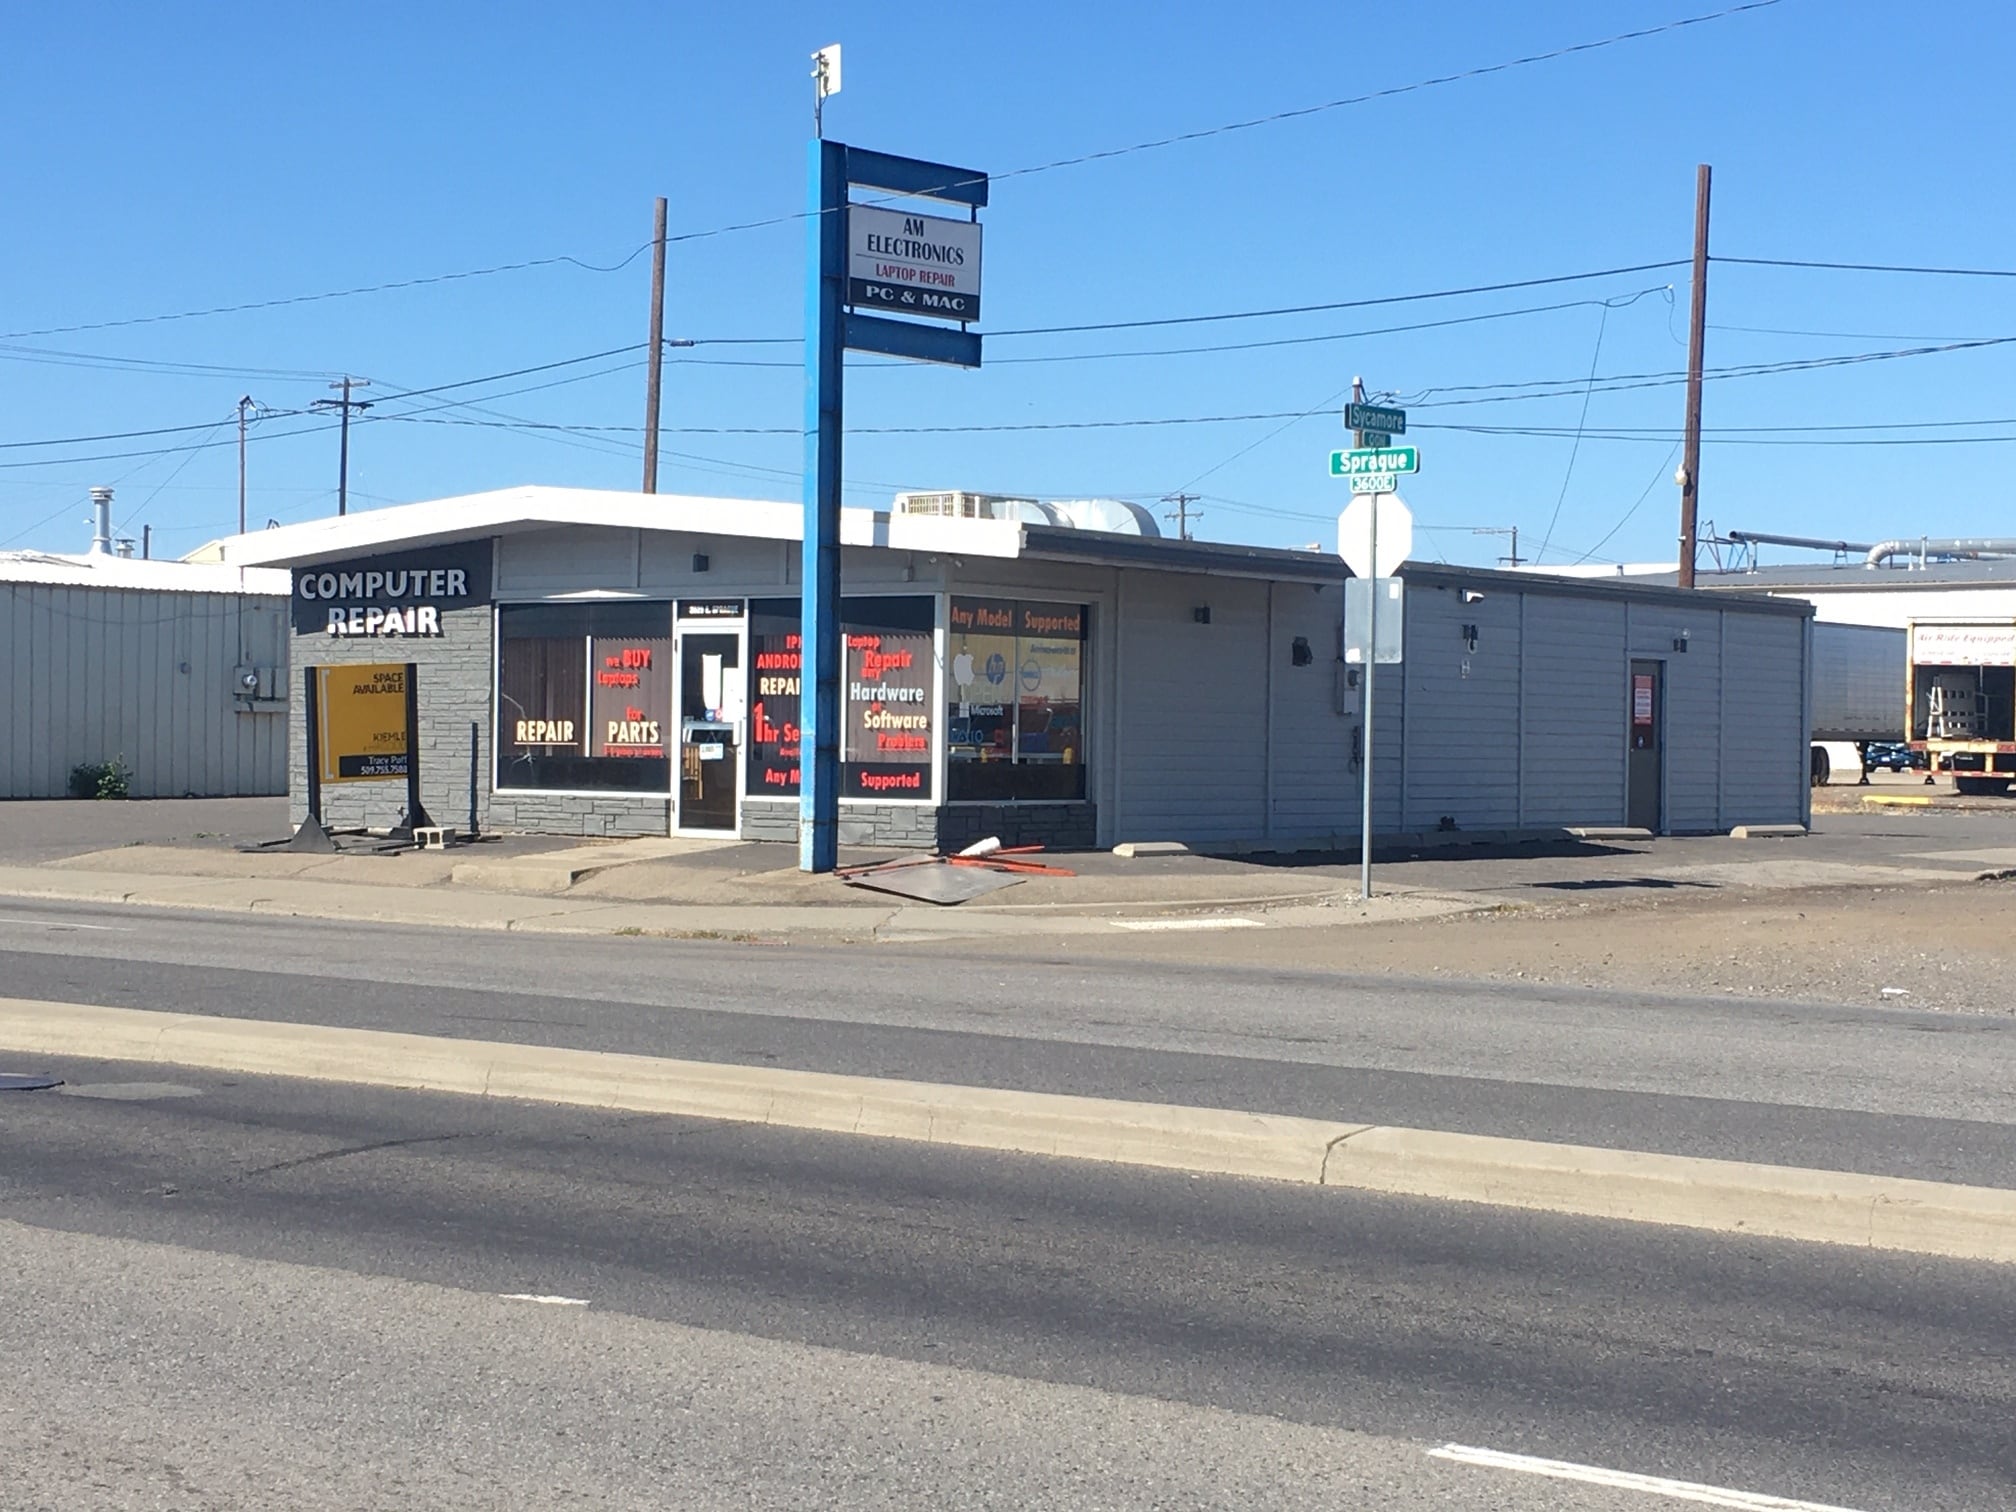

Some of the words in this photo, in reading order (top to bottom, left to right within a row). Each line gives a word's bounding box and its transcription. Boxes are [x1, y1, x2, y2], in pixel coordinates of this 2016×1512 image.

[903, 217, 924, 237] AM
[867, 233, 964, 266] ELECTRONICS
[875, 263, 916, 283] LAPTOP
[919, 269, 955, 288] REPAIR
[866, 285, 894, 300] PC
[900, 291, 916, 304] &
[922, 293, 965, 311] MAC
[1352, 406, 1403, 430] Sycamore
[1339, 452, 1408, 474] Sprague
[1354, 476, 1392, 490] 3600E
[299, 568, 468, 600] COMPUTER
[327, 605, 440, 635] REPAIR
[951, 606, 973, 628] Any
[976, 608, 1013, 628] Model
[1024, 609, 1081, 633] Supported
[847, 634, 881, 650] Laptop
[1962, 633, 2015, 645] Equipped
[605, 656, 620, 668] we
[622, 648, 651, 668] BUY
[756, 653, 802, 669] ANDROI
[864, 648, 912, 672] Repair
[373, 672, 404, 684] SPACE
[597, 669, 639, 687] Laptops
[861, 666, 881, 681] any
[352, 682, 405, 695] AVAILABLE
[760, 676, 800, 695] REPAI
[850, 681, 924, 702] Hardware
[863, 709, 928, 729] Software
[516, 719, 574, 742] REPAIR
[608, 720, 659, 743] PARTS
[877, 731, 926, 749] Problem
[765, 767, 787, 787] Any
[860, 772, 921, 791] Supported
